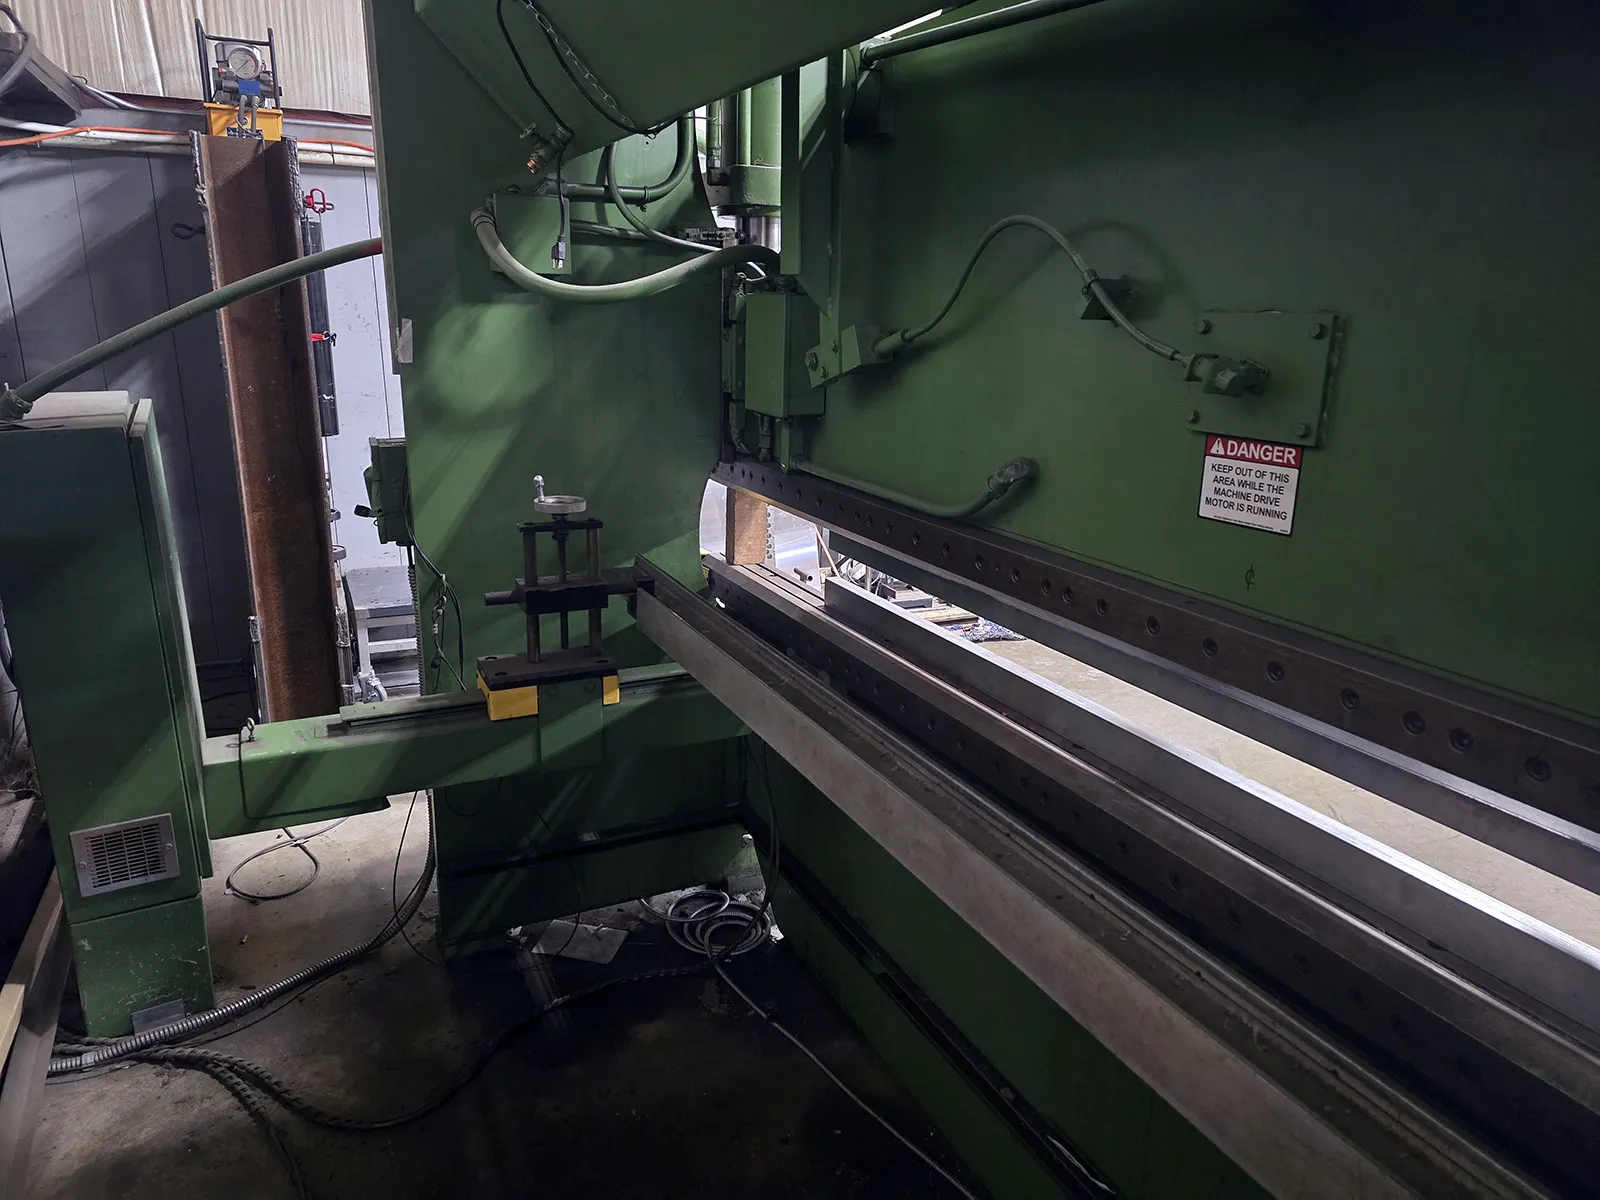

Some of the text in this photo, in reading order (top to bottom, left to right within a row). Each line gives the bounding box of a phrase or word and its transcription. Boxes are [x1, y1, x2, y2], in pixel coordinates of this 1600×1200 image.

[1227, 440, 1296, 464] DANGER
[1211, 463, 1289, 483] KEEP OUT OF THIS
[1213, 475, 1284, 494] AREA WHILE THE
[1214, 487, 1280, 506] MACHINE DRIVE
[1205, 497, 1287, 520] MOTOR IS RUNNING
